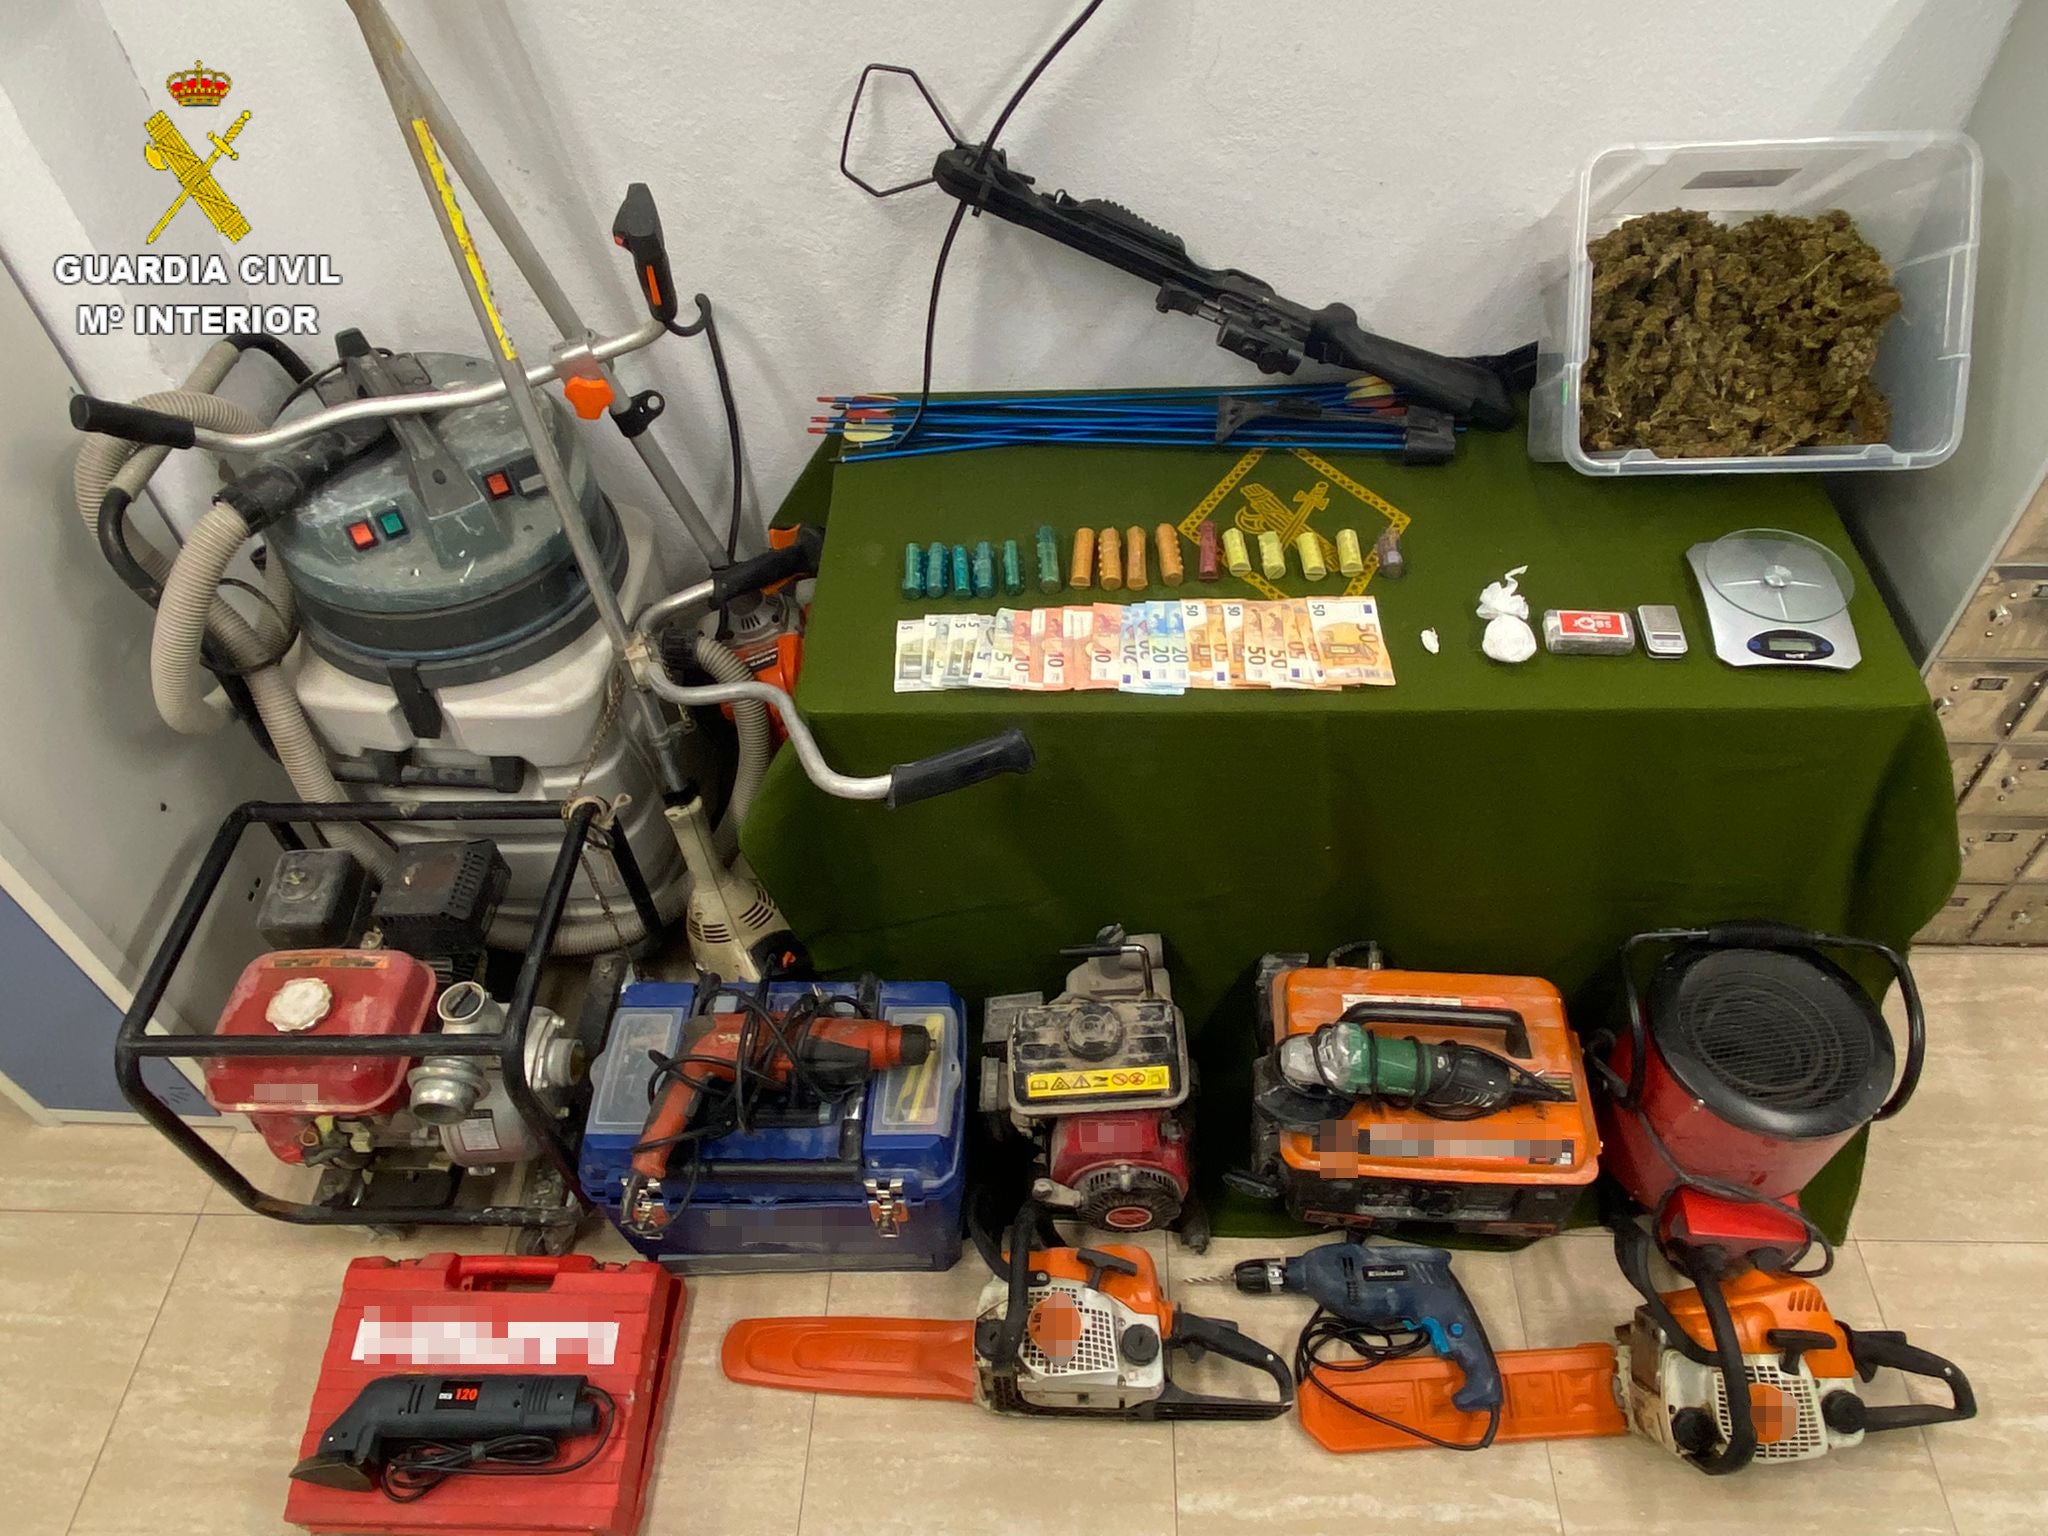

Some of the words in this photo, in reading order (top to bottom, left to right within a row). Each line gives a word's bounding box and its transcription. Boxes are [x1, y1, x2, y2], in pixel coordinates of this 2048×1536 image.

[1185, 604, 1198, 617] 50
[1312, 604, 1325, 616] 50
[1356, 623, 1379, 643] 50
[995, 652, 1012, 662] 5
[1047, 652, 1065, 668] 10
[1094, 649, 1112, 663] 10
[1152, 645, 1170, 664] 20
[1172, 646, 1189, 664] 20
[1248, 645, 1266, 665] 50
[1269, 649, 1288, 669] 50
[1014, 655, 1030, 672] 10
[456, 1388, 478, 1401] 120
